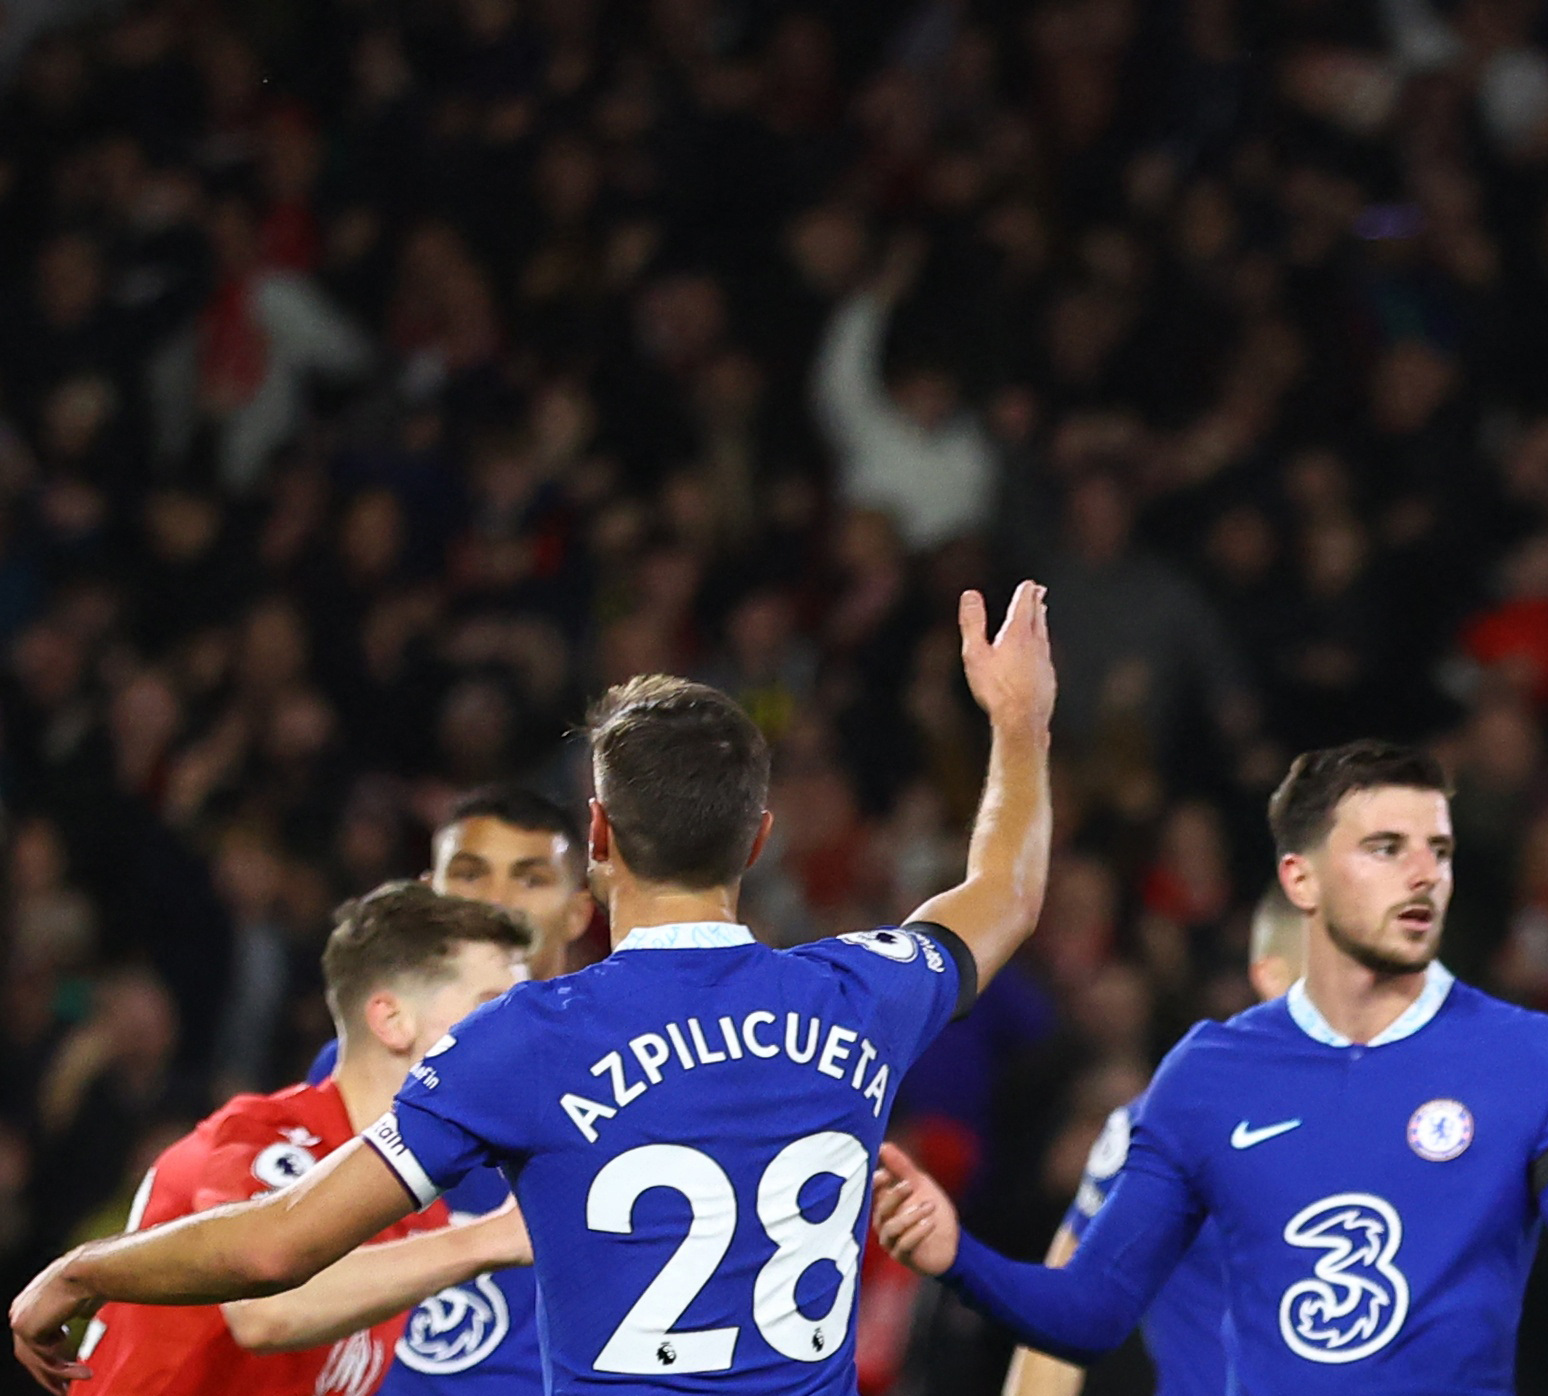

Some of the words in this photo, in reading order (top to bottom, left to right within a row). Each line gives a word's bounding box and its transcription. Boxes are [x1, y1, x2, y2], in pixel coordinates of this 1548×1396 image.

[560, 1010, 892, 1143] AZPILICUETA
[586, 1131, 871, 1375] 28
[1278, 1192, 1409, 1364] 3
